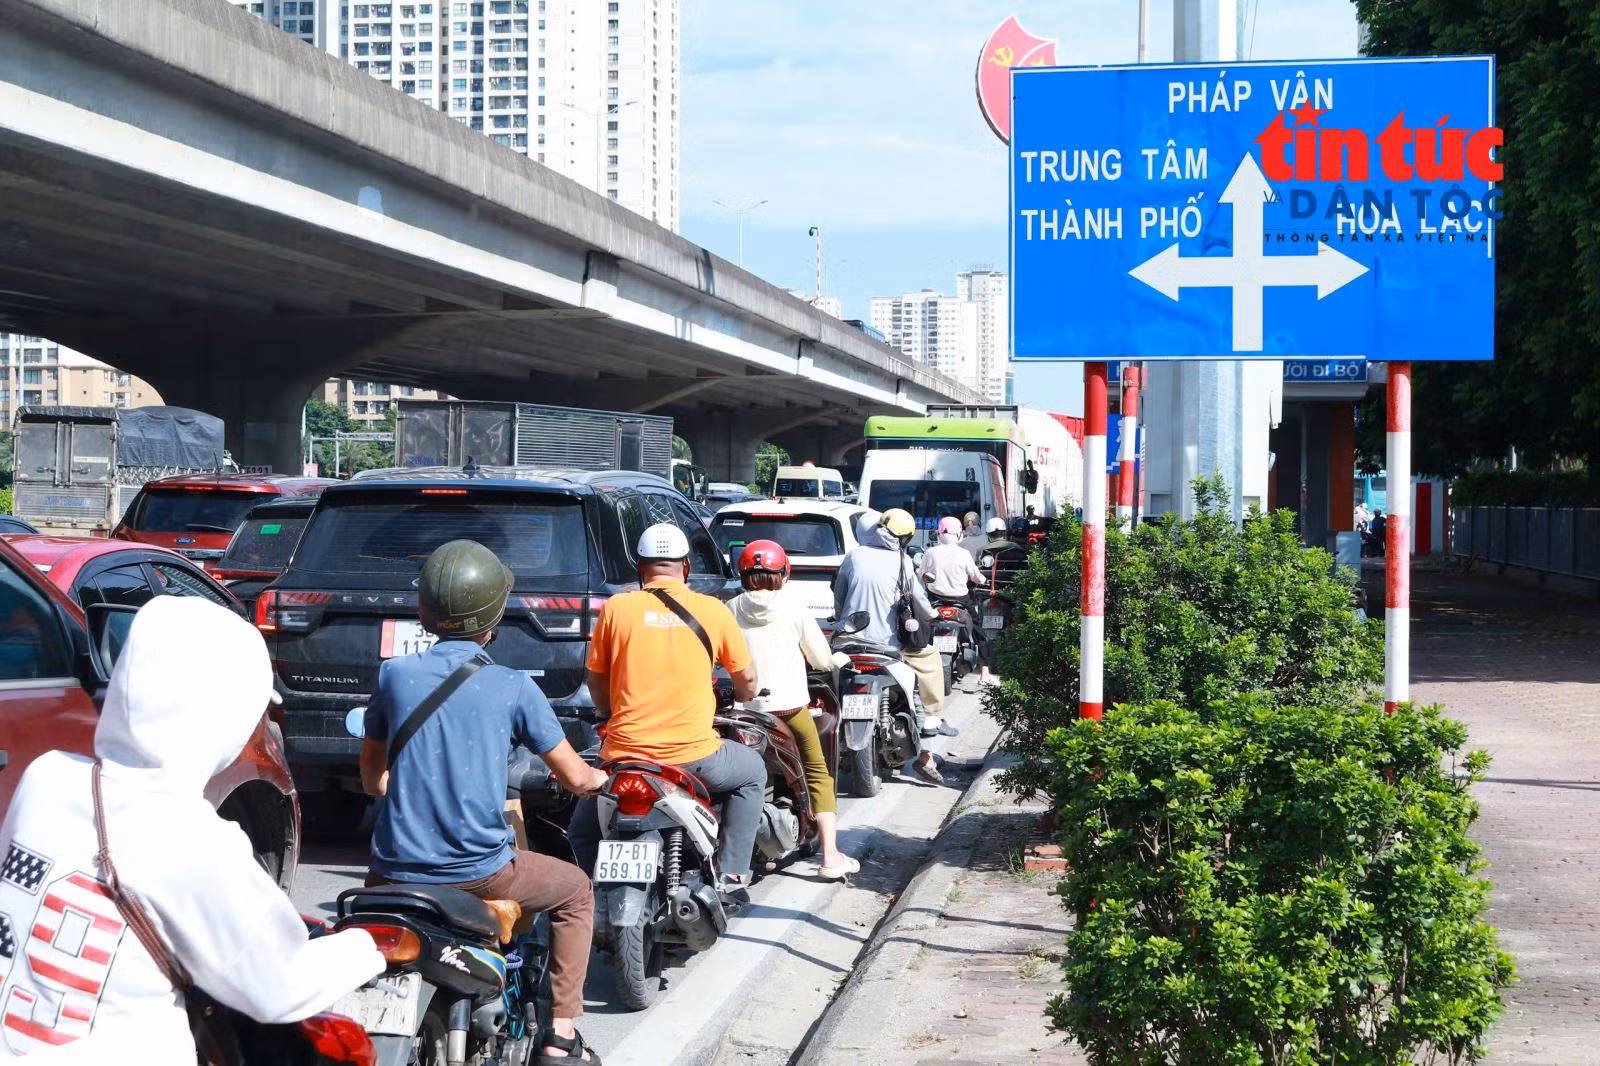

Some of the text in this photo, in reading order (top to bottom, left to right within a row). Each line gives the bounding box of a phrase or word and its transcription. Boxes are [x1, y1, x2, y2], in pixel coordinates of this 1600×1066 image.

[1168, 70, 1333, 113] PHÁP VÂN
[1020, 139, 1208, 183] TRUNG TÂM
[1020, 192, 1204, 240] THÀNH PHỐ
[291, 675, 359, 685] TITANIUM
[608, 843, 649, 861] 17-B1
[599, 862, 653, 880] 569.18
